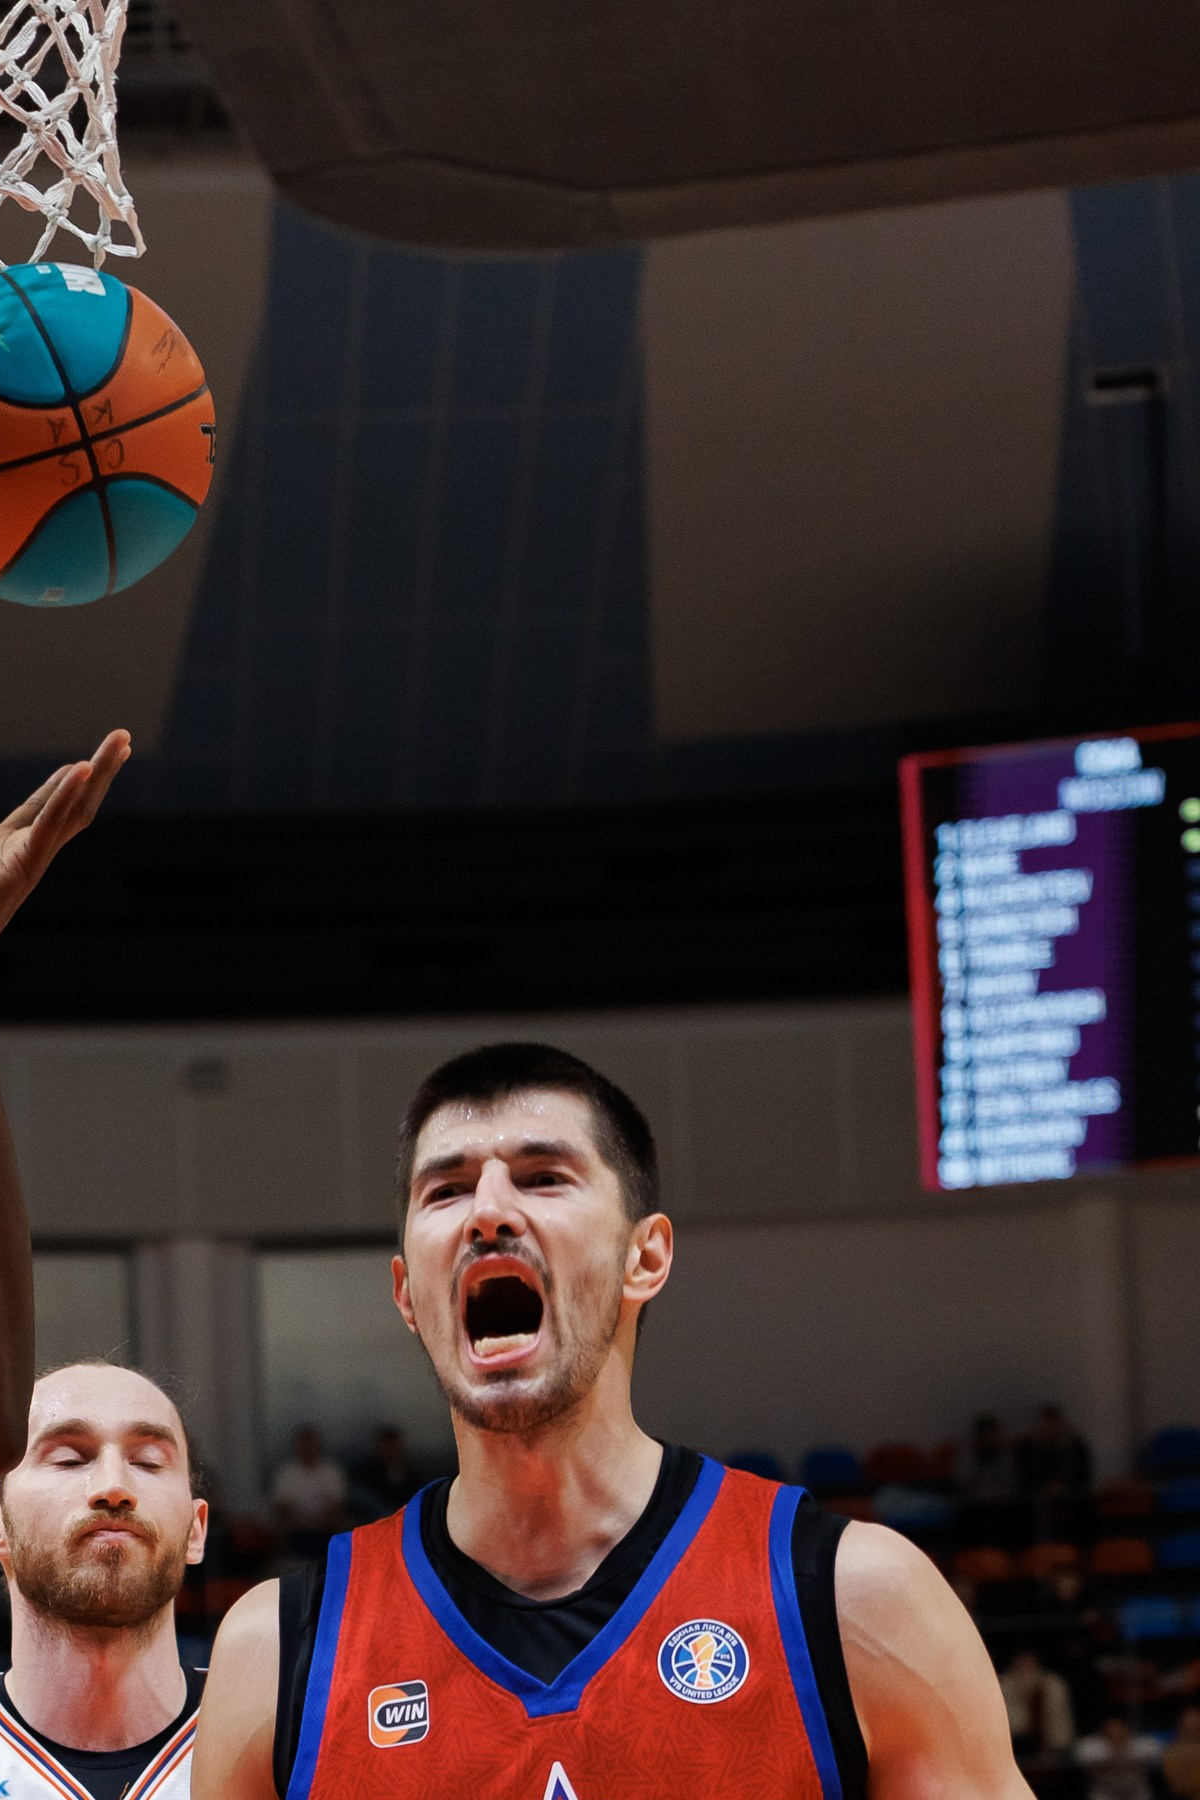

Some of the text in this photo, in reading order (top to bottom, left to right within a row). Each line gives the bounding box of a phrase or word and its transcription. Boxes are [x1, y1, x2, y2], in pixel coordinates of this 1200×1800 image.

[667, 1623, 739, 1648] ЕДИНАЯ ЛИГА ВТБ
[669, 1674, 740, 1699] VTB UNITED LEAGUE
[385, 1700, 425, 1725] WIN
